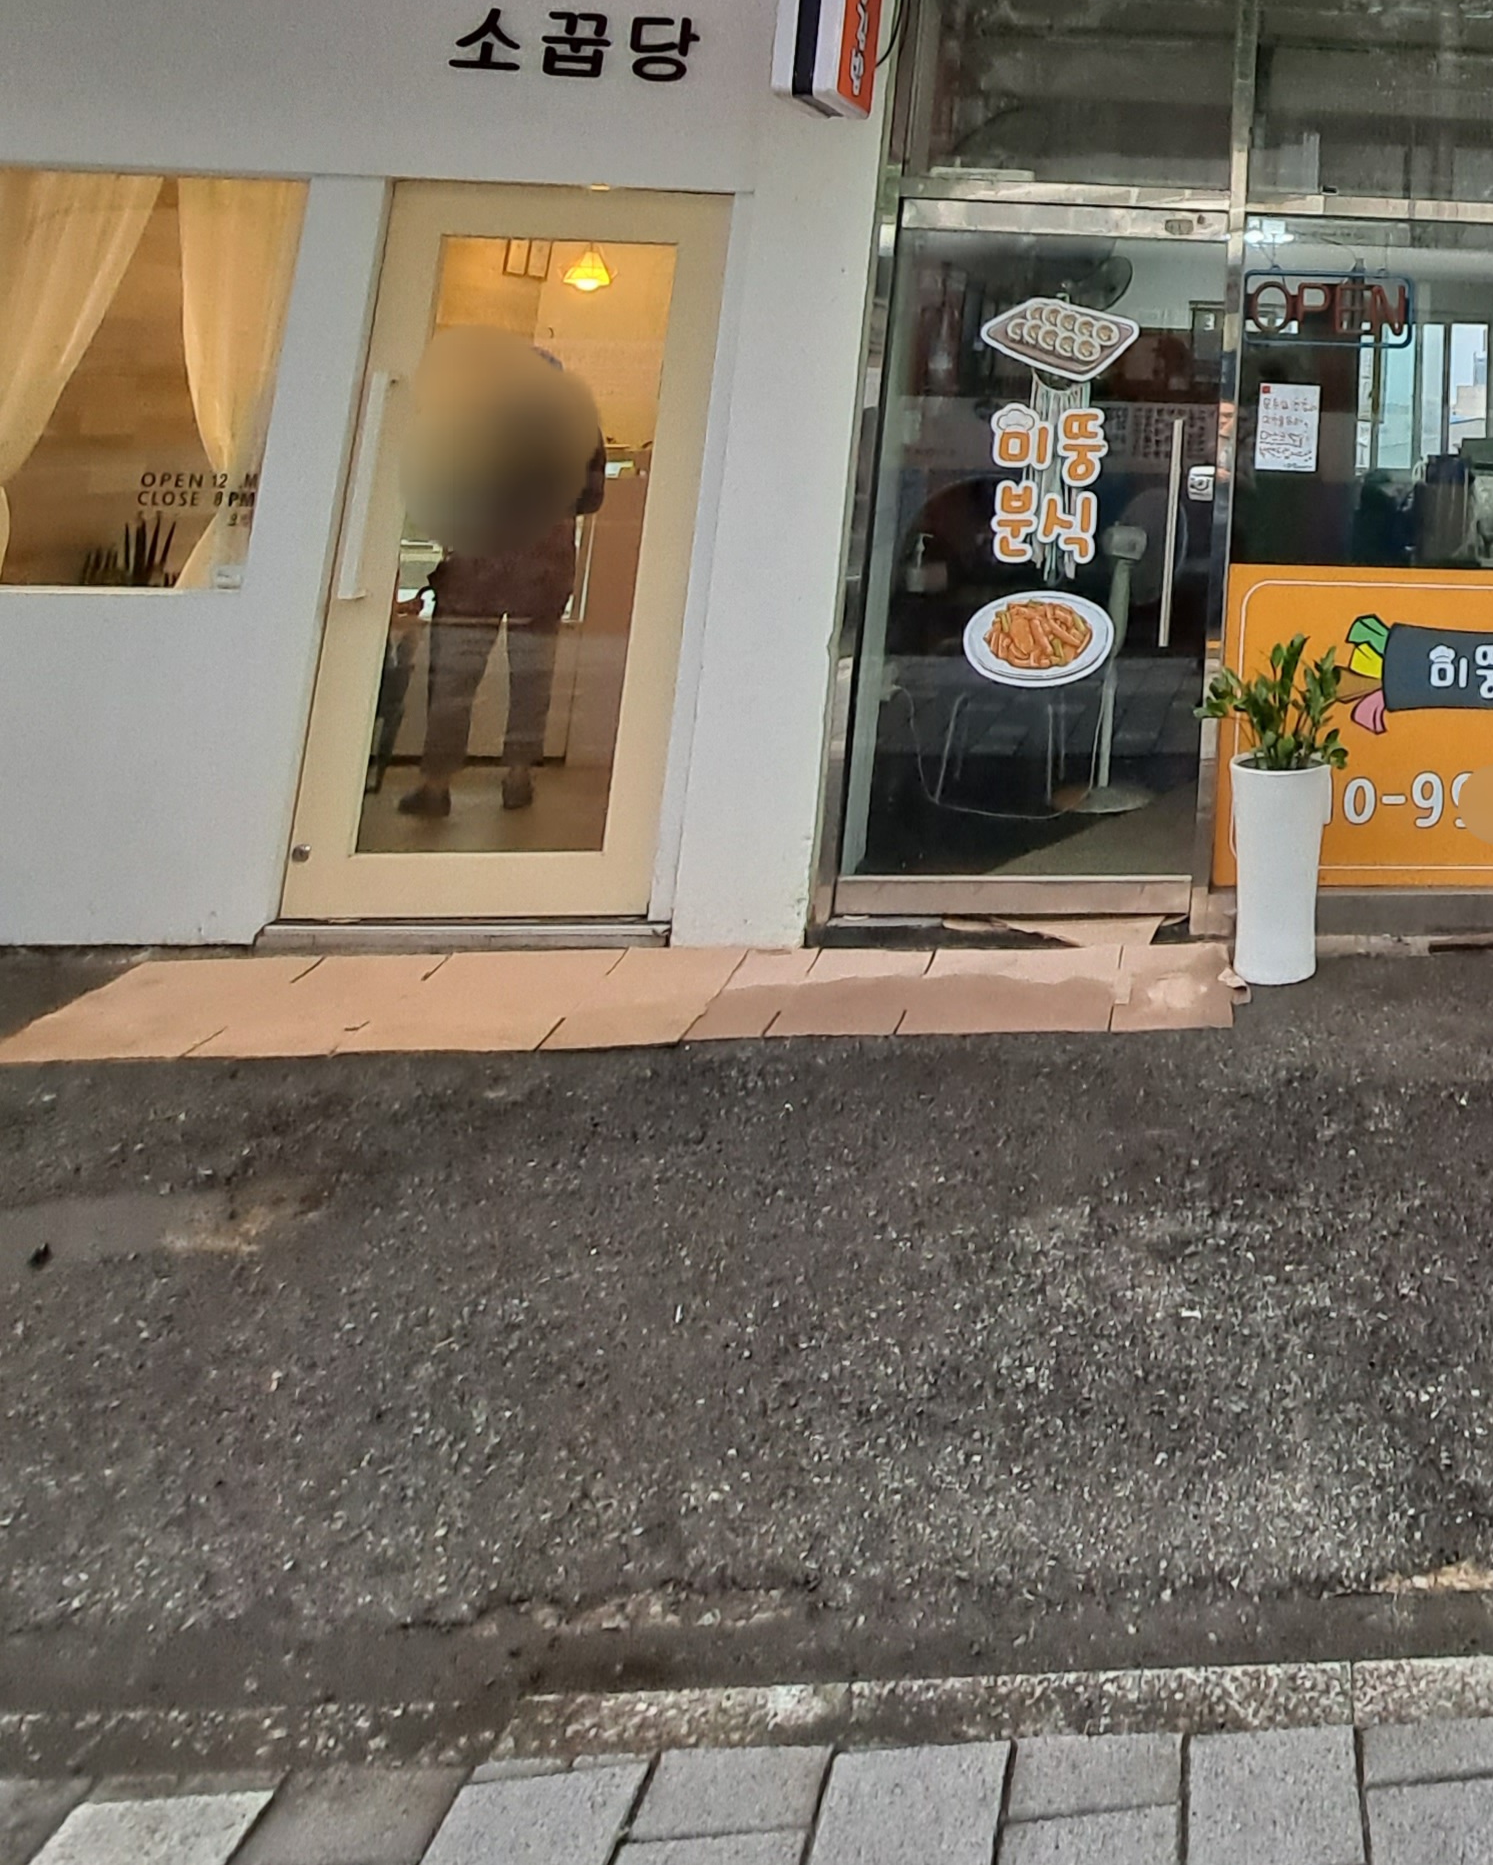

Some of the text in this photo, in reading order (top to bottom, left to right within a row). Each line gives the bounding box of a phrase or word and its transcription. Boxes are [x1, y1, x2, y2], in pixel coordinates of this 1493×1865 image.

[448, 7, 701, 83] 소꿉당
[1252, 280, 1406, 337] OPEN
[997, 409, 1107, 484] 미뚱
[137, 490, 200, 507] CLOSE
[140, 471, 204, 489] OPEN
[997, 484, 1095, 560] 분식
